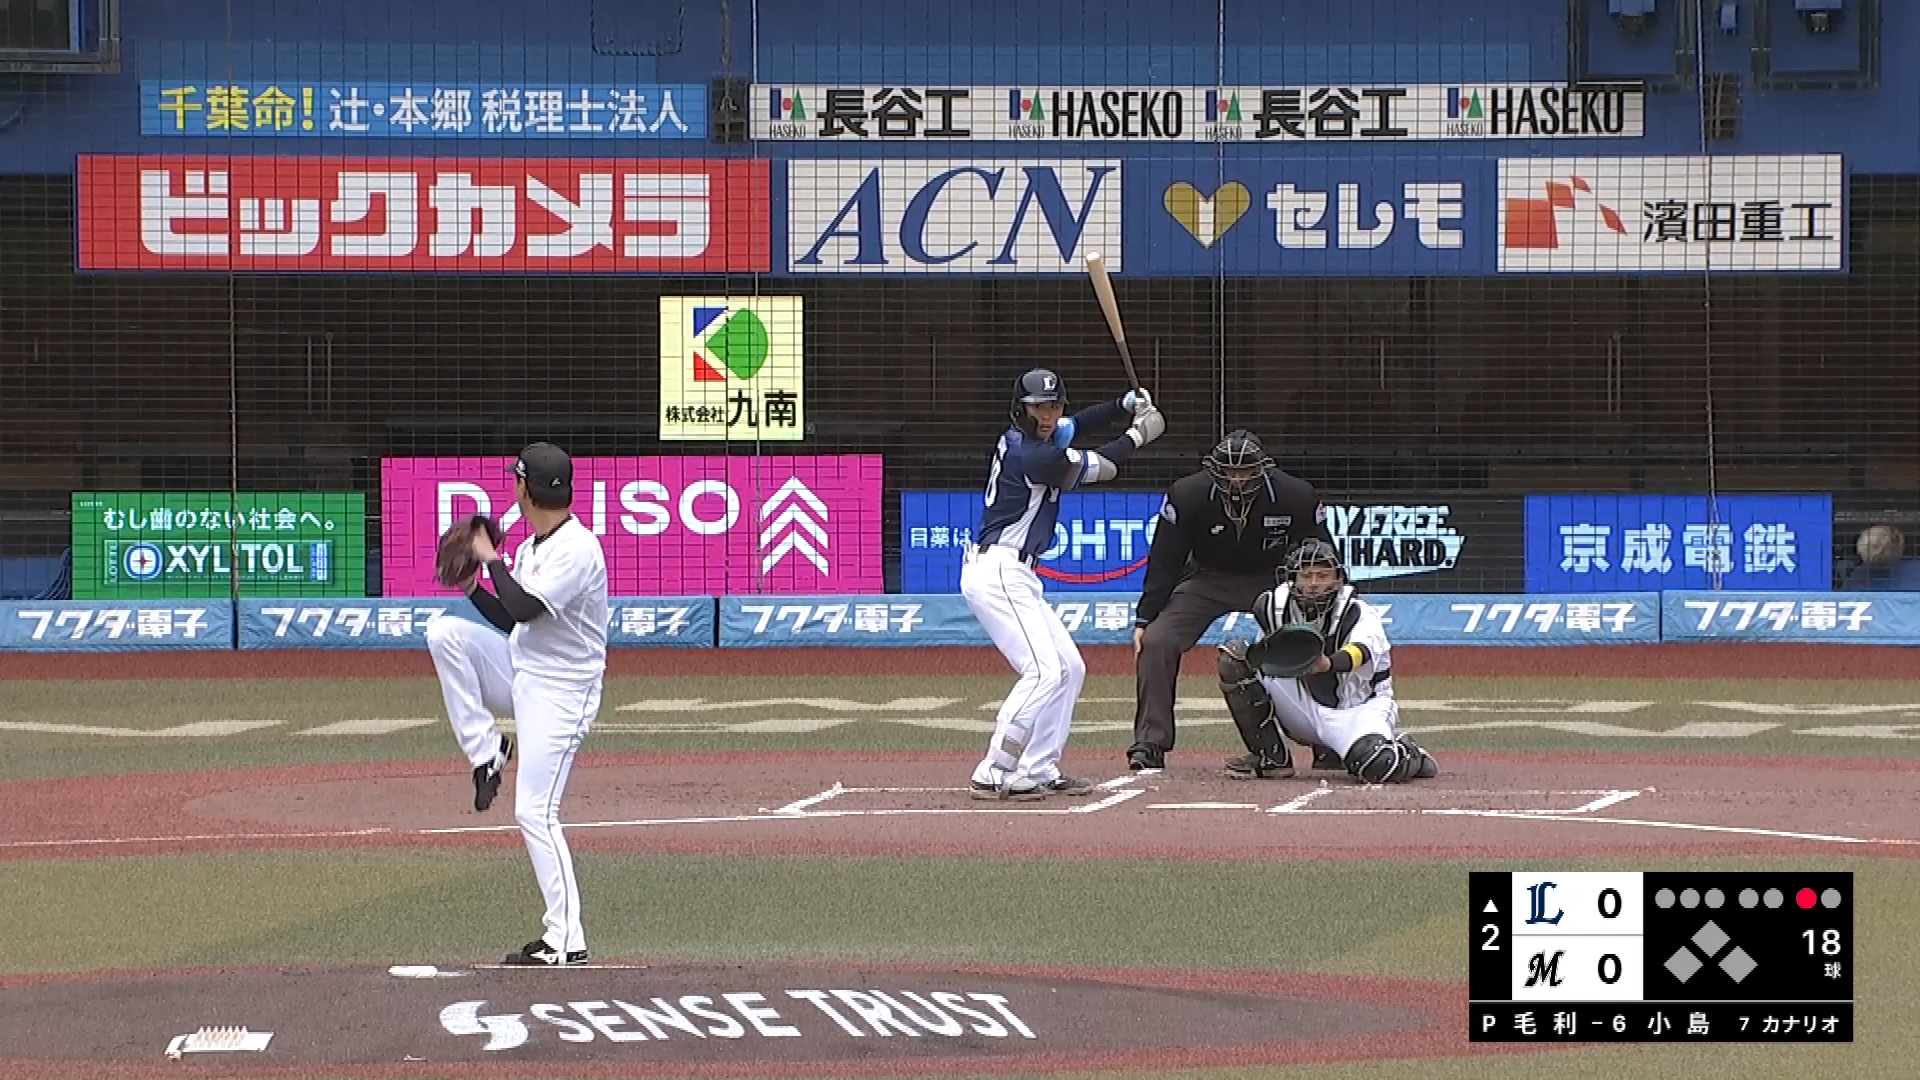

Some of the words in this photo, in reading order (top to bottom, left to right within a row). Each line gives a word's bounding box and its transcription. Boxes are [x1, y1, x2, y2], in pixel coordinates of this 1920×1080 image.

[158, 85, 314, 131] 千葉命!
[329, 87, 471, 132] 辻・本郷
[482, 88, 690, 133] 税理士法人
[769, 123, 807, 138] HASEKO
[817, 87, 971, 137] 長谷工
[1052, 91, 1184, 138] HASEKO
[1253, 87, 1408, 138] 長谷工
[1204, 125, 1243, 140] HASEKO
[140, 169, 711, 257] ビックカメラ
[793, 166, 1117, 265] ACN
[1266, 182, 1466, 249] セレモ
[1643, 199, 1834, 243] 濱田重工
[103, 507, 335, 531] むし歯のない社会へ。
[437, 479, 740, 536] DISO
[1359, 505, 1457, 535] FREE.
[1351, 537, 1453, 567] HARD.
[1559, 522, 1798, 573] 京成電鉄
[18, 609, 209, 639] フクダ電子
[741, 603, 924, 633] フクダ電子
[1450, 602, 1636, 633] フクダ電子
[1684, 600, 1873, 631] フクダ電子
[529, 991, 802, 1042] SENSE
[785, 988, 1038, 1040] TRUST
